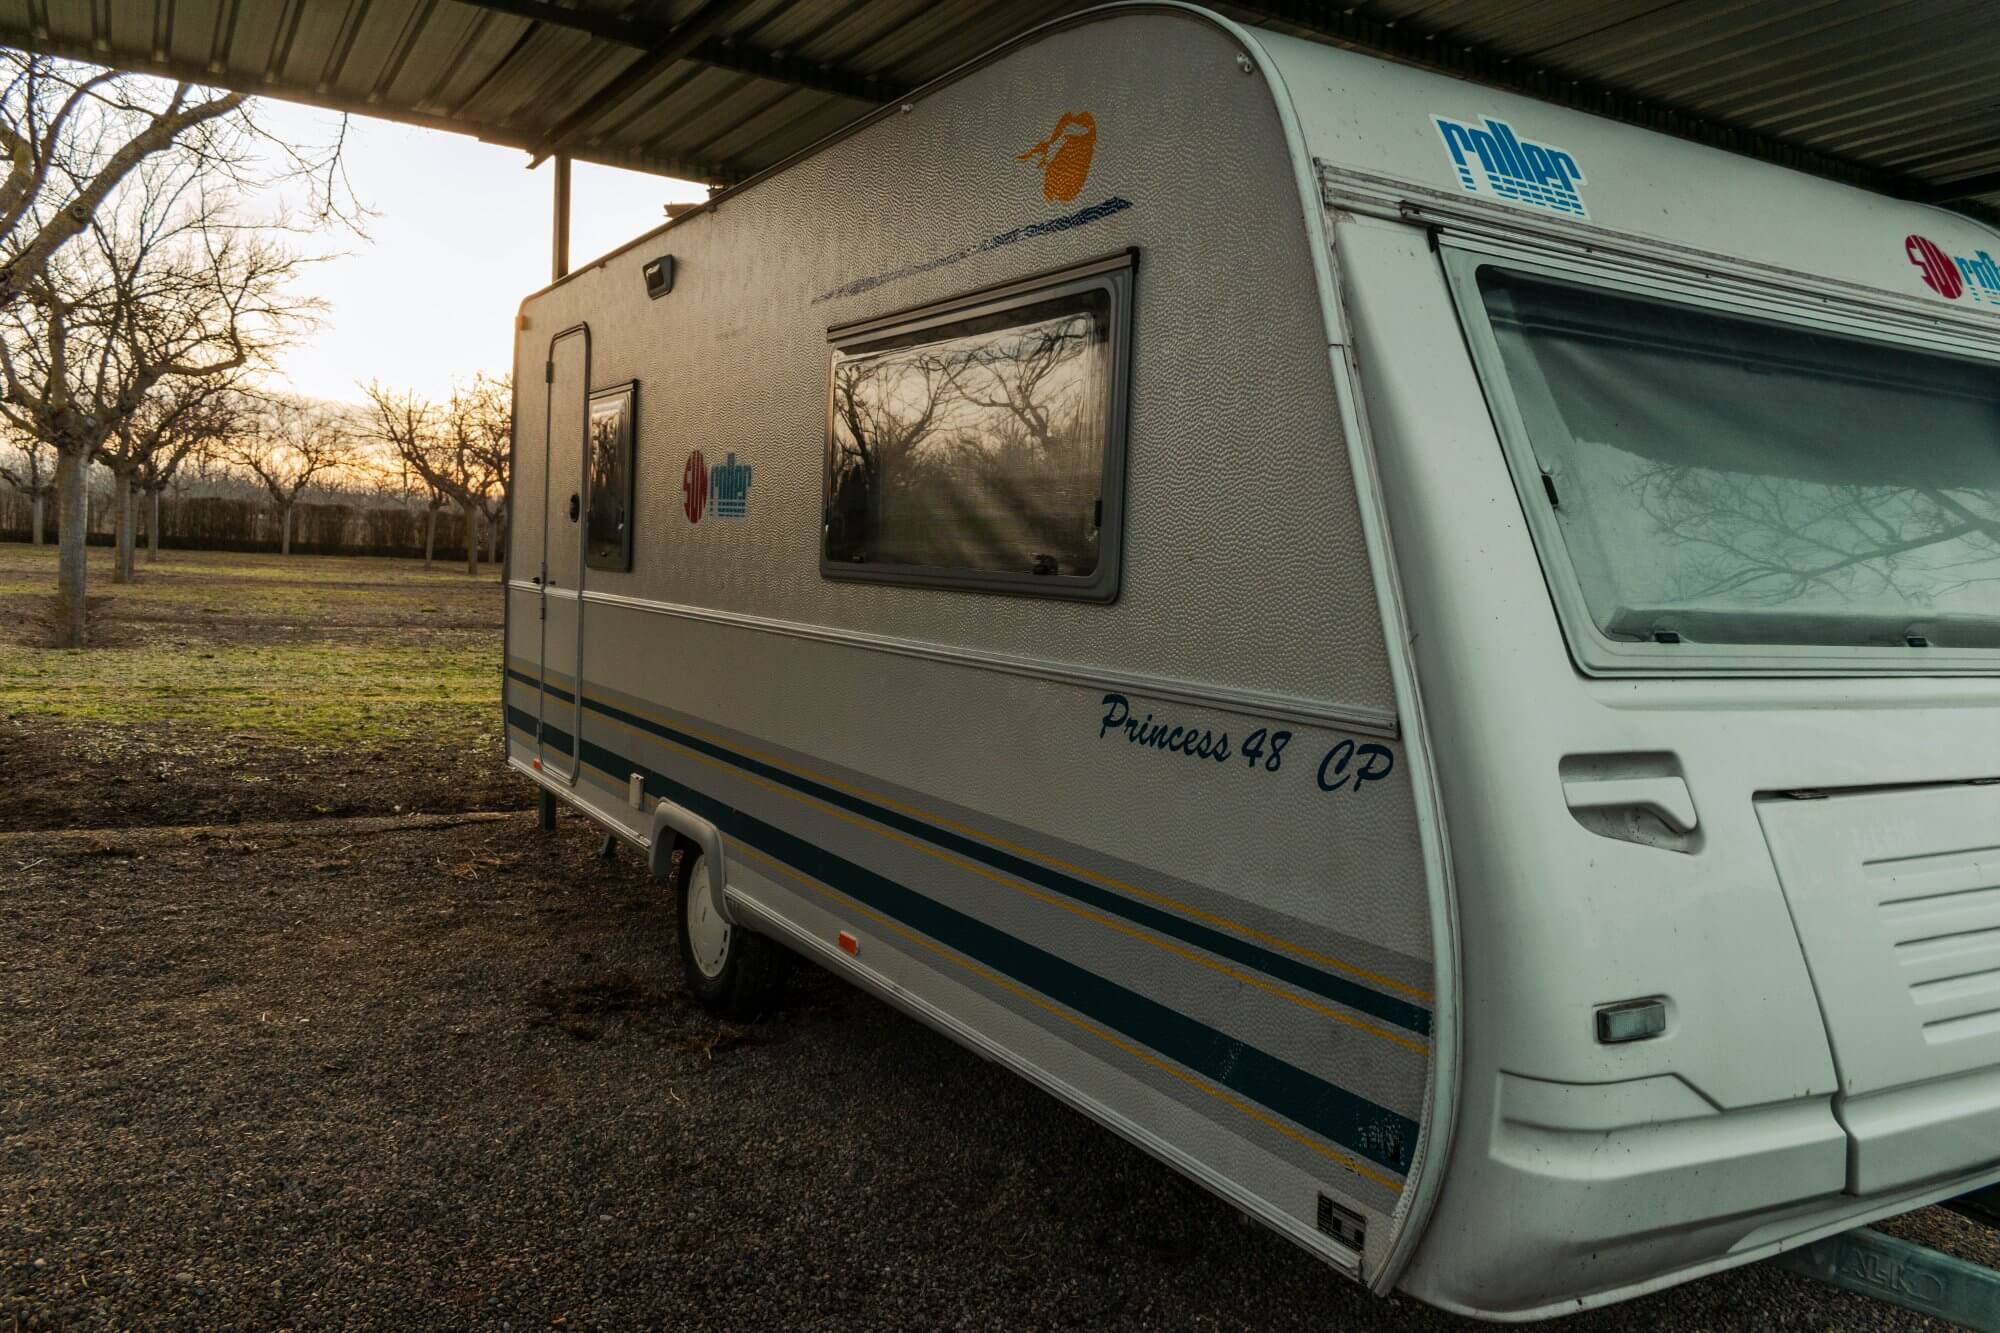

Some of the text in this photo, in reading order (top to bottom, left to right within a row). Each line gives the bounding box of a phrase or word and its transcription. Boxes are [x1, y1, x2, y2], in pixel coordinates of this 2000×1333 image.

[1436, 119, 1586, 216] roller
[1904, 233, 2000, 305] SUN roll
[683, 450, 708, 524] SUN
[1100, 693, 1395, 792] Princess 48 CP
